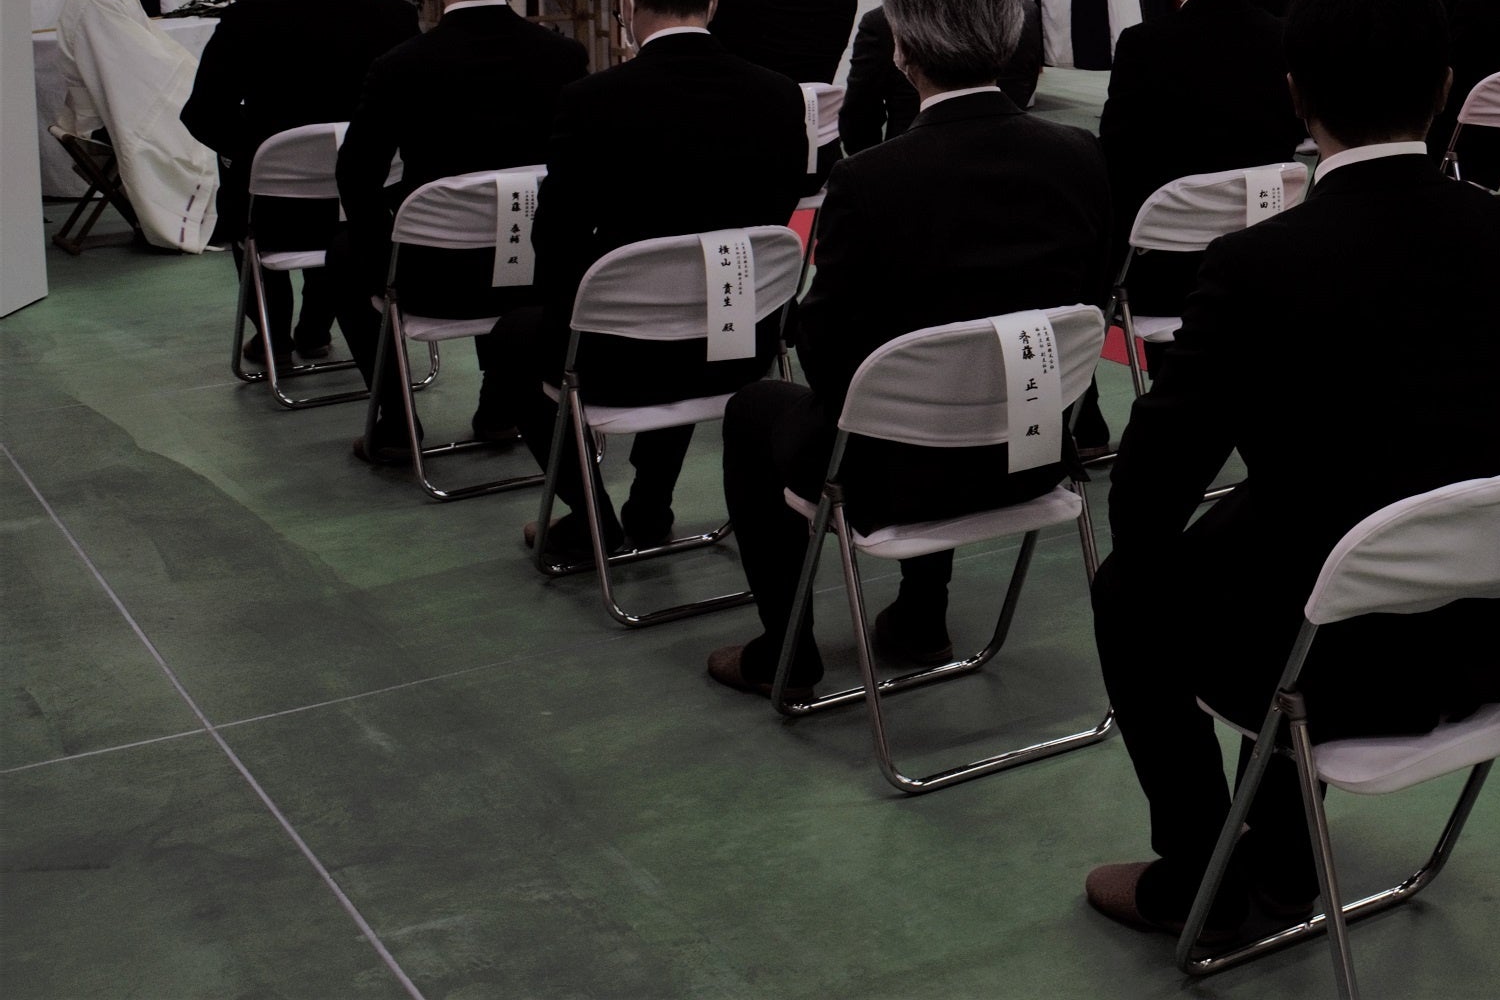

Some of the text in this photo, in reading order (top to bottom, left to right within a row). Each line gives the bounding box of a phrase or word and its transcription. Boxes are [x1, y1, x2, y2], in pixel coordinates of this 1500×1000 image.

[1259, 190, 1268, 209] 松田
[718, 245, 735, 332] 横山 貴生 殿
[1025, 378, 1038, 402] 正一
[1026, 424, 1040, 437] 殿
